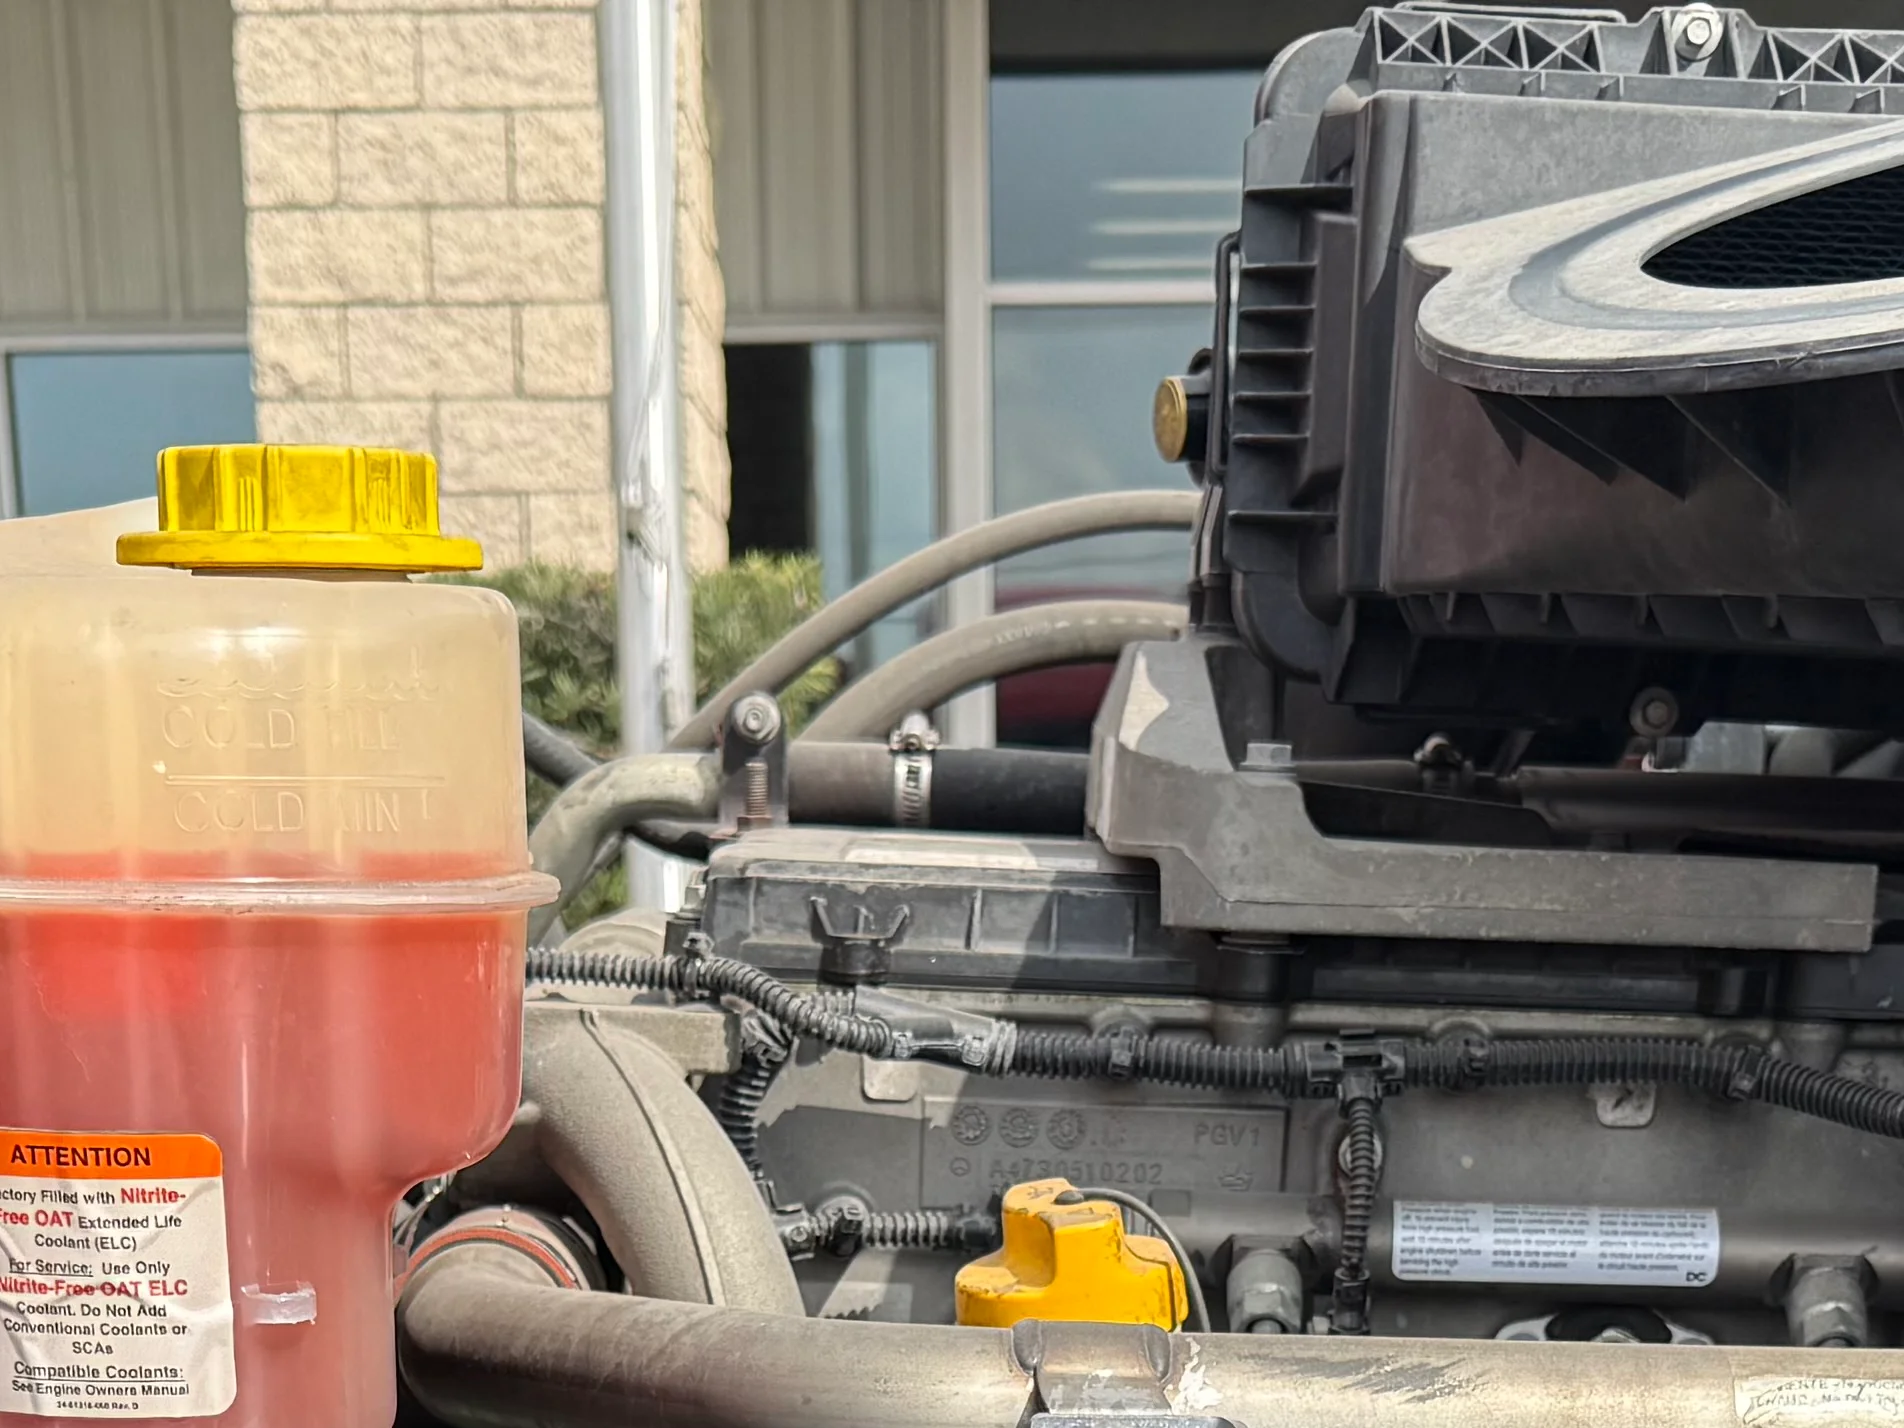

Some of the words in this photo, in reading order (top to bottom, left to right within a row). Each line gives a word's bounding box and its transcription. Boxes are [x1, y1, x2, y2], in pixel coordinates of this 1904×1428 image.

[163, 704, 298, 750] COLD
[174, 790, 306, 833] COLD
[1195, 1121, 1261, 1147] PGV1
[10, 1144, 152, 1167] ATTENTION
[41, 1189, 78, 1205] Filled
[83, 1192, 115, 1205] with
[120, 1187, 187, 1204] Nitrite-
[35, 1210, 74, 1227] OAT
[78, 1216, 150, 1230] Extended
[154, 1215, 183, 1228] Life
[34, 1233, 91, 1250] Coolant
[94, 1235, 137, 1252] (ELC)
[9, 1259, 32, 1273] For
[35, 1259, 93, 1275] Service:
[101, 1261, 130, 1275] Use
[135, 1261, 171, 1277] Only
[1685, 1271, 1708, 1284] DC
[99, 1282, 142, 1298] OAT
[149, 1279, 188, 1296] ELC
[16, 1301, 76, 1317] Coolant.
[80, 1304, 101, 1318] Do
[105, 1304, 132, 1318] Not
[136, 1304, 167, 1318] Add
[3, 1318, 95, 1335] Conventional
[99, 1322, 167, 1336] Coolants
[171, 1325, 188, 1336] or
[71, 1341, 114, 1355] SCAs
[13, 1361, 100, 1381] Compatible
[105, 1366, 184, 1379] Coolants:
[11, 1380, 33, 1394] See
[35, 1383, 81, 1398] Engine
[85, 1383, 137, 1396] Owners
[141, 1383, 190, 1396] Manual
